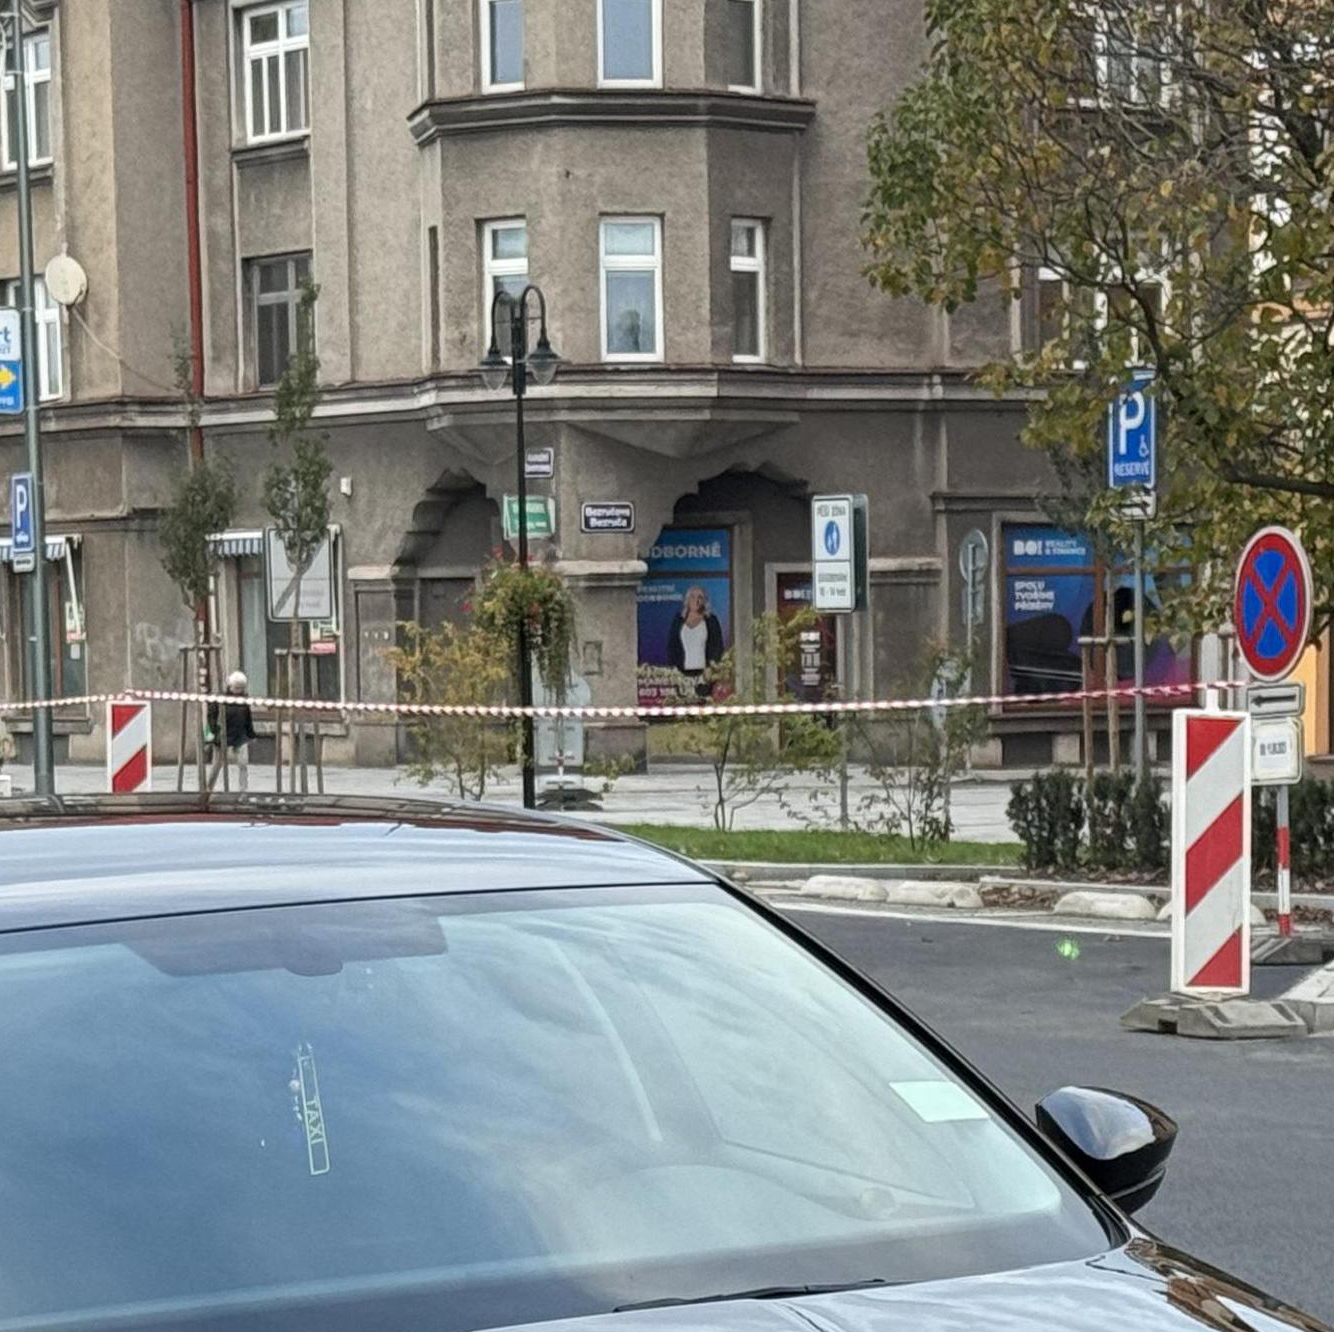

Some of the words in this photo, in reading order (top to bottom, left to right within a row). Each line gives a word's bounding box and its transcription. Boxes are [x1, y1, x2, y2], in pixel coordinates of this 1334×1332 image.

[1119, 391, 1145, 455] P
[16, 484, 28, 529] P
[305, 1096, 326, 1145] TAXI
